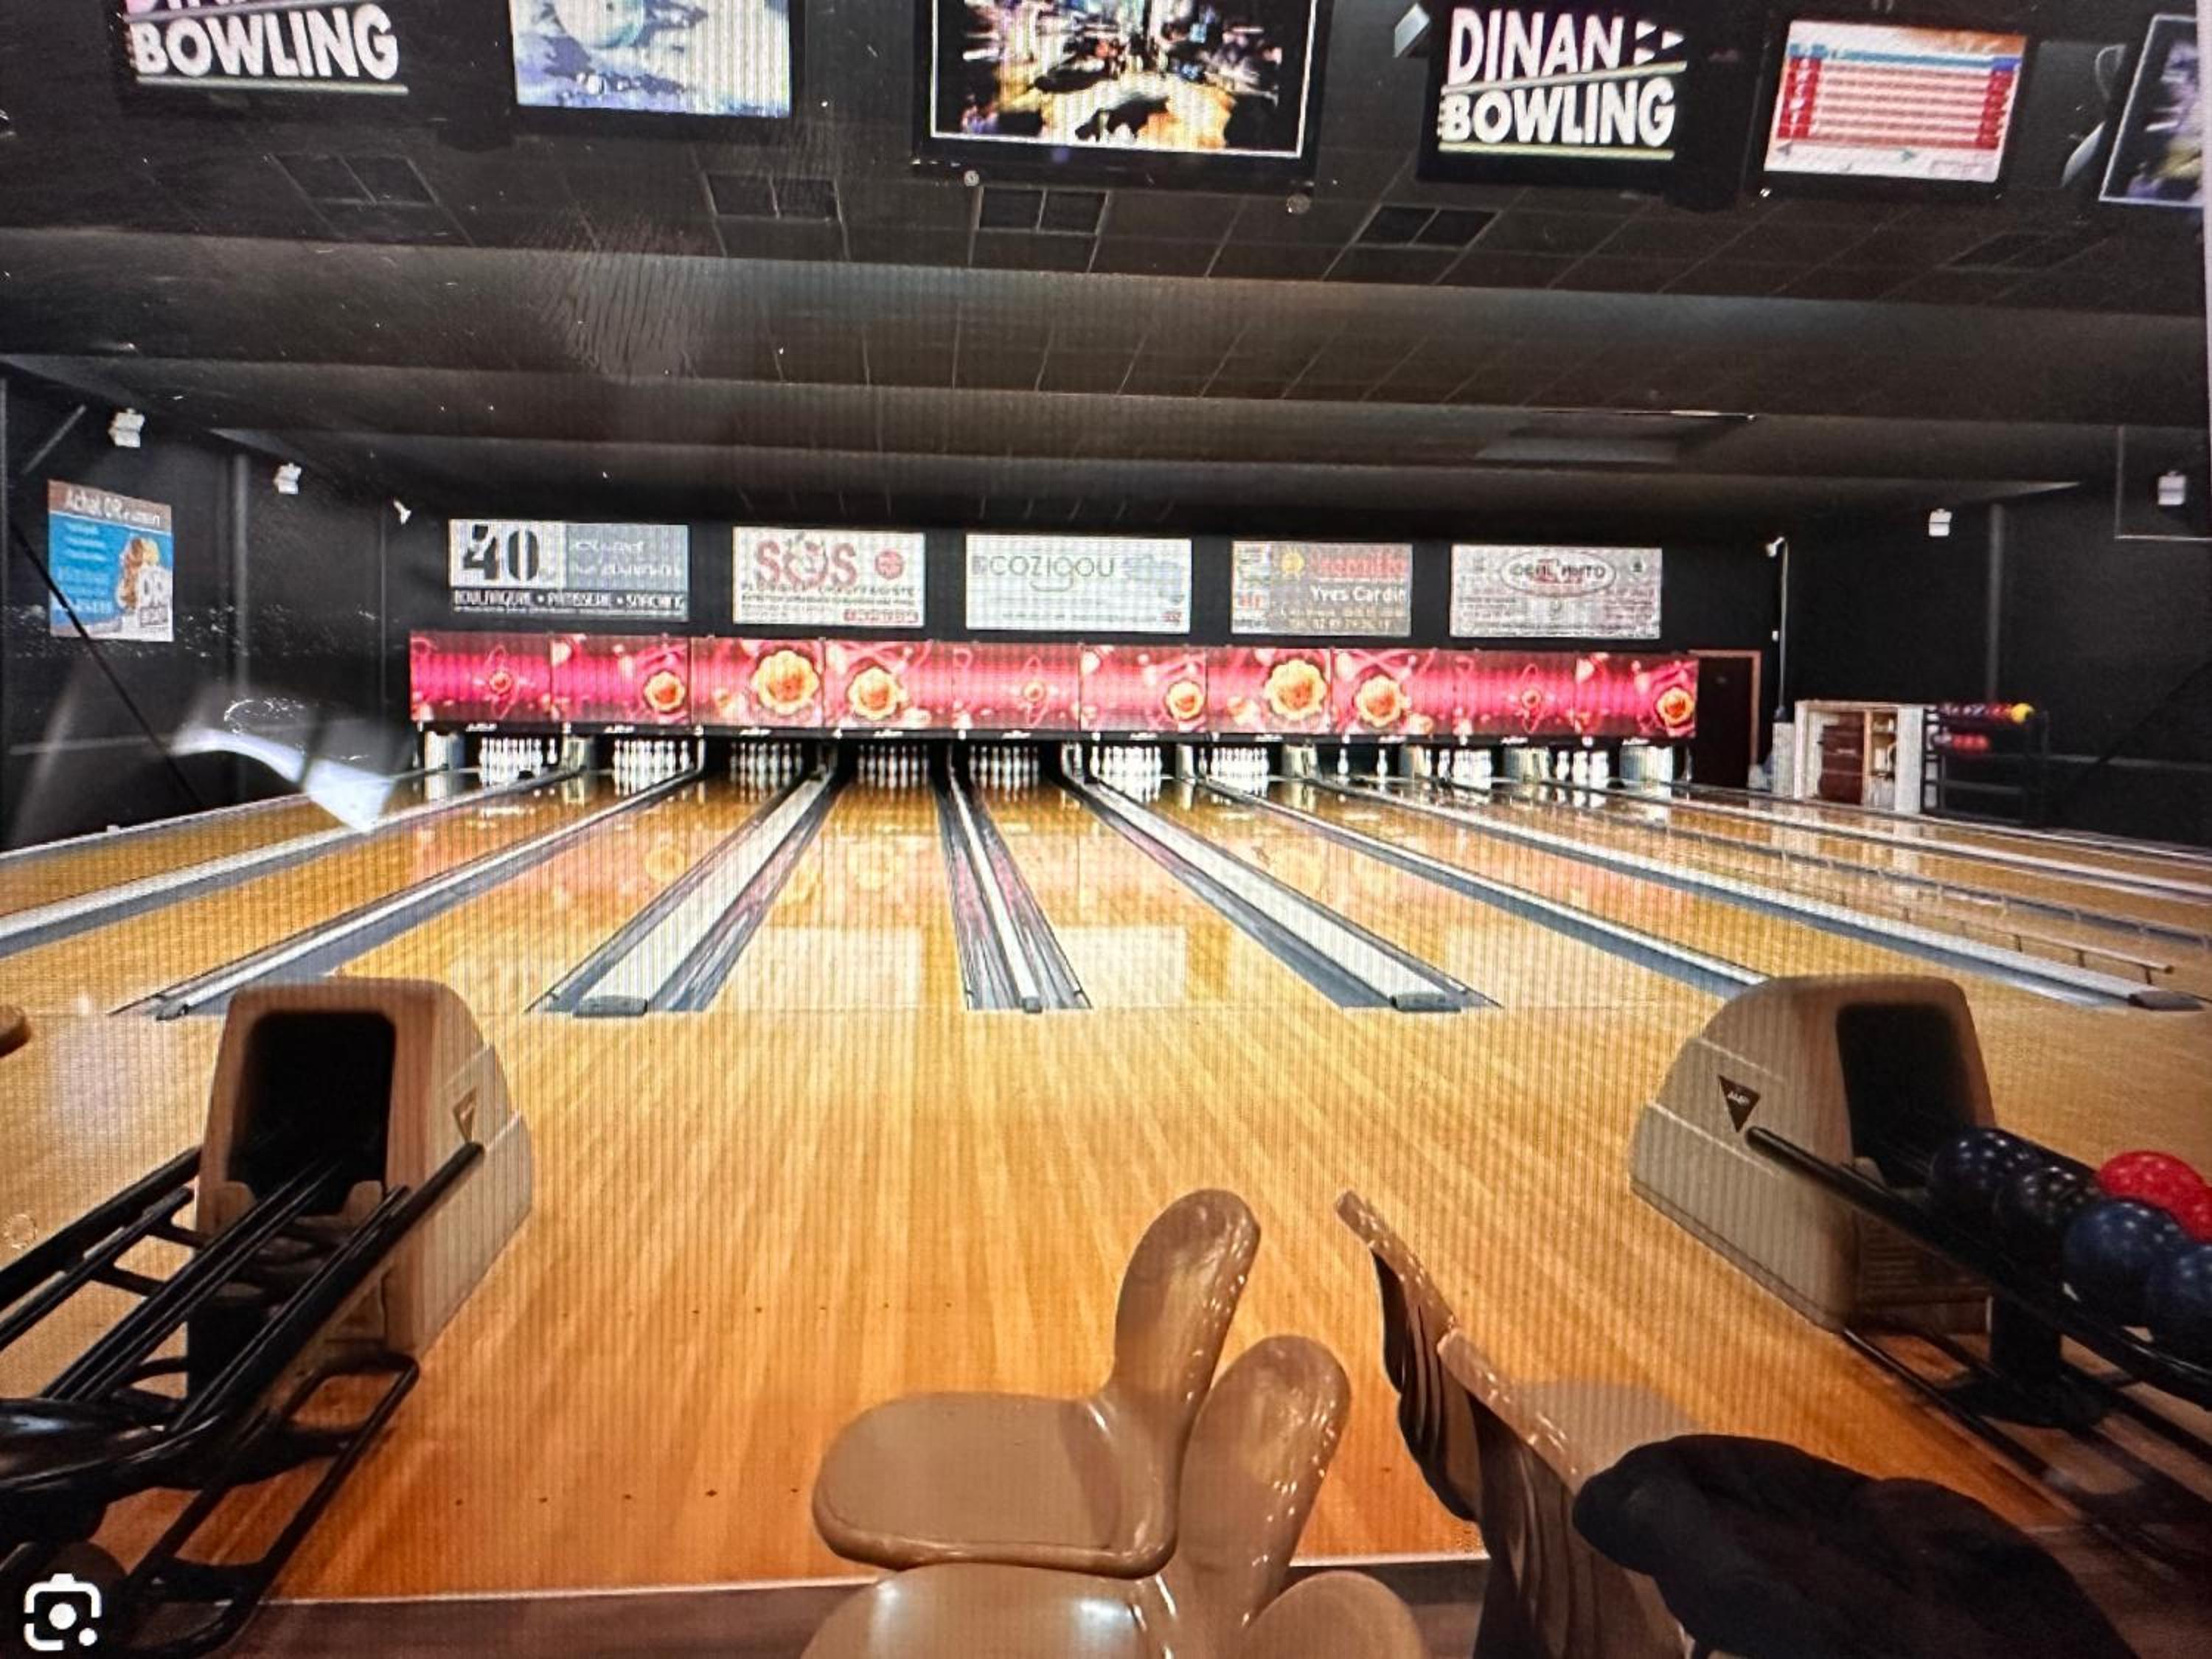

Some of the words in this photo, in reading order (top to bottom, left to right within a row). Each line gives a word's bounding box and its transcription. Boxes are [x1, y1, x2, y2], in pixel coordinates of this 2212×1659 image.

[129, 3, 400, 80] BOWLING
[1448, 7, 1625, 86] DINAN
[1439, 77, 1676, 147] BOWLING
[756, 539, 858, 588] SOS
